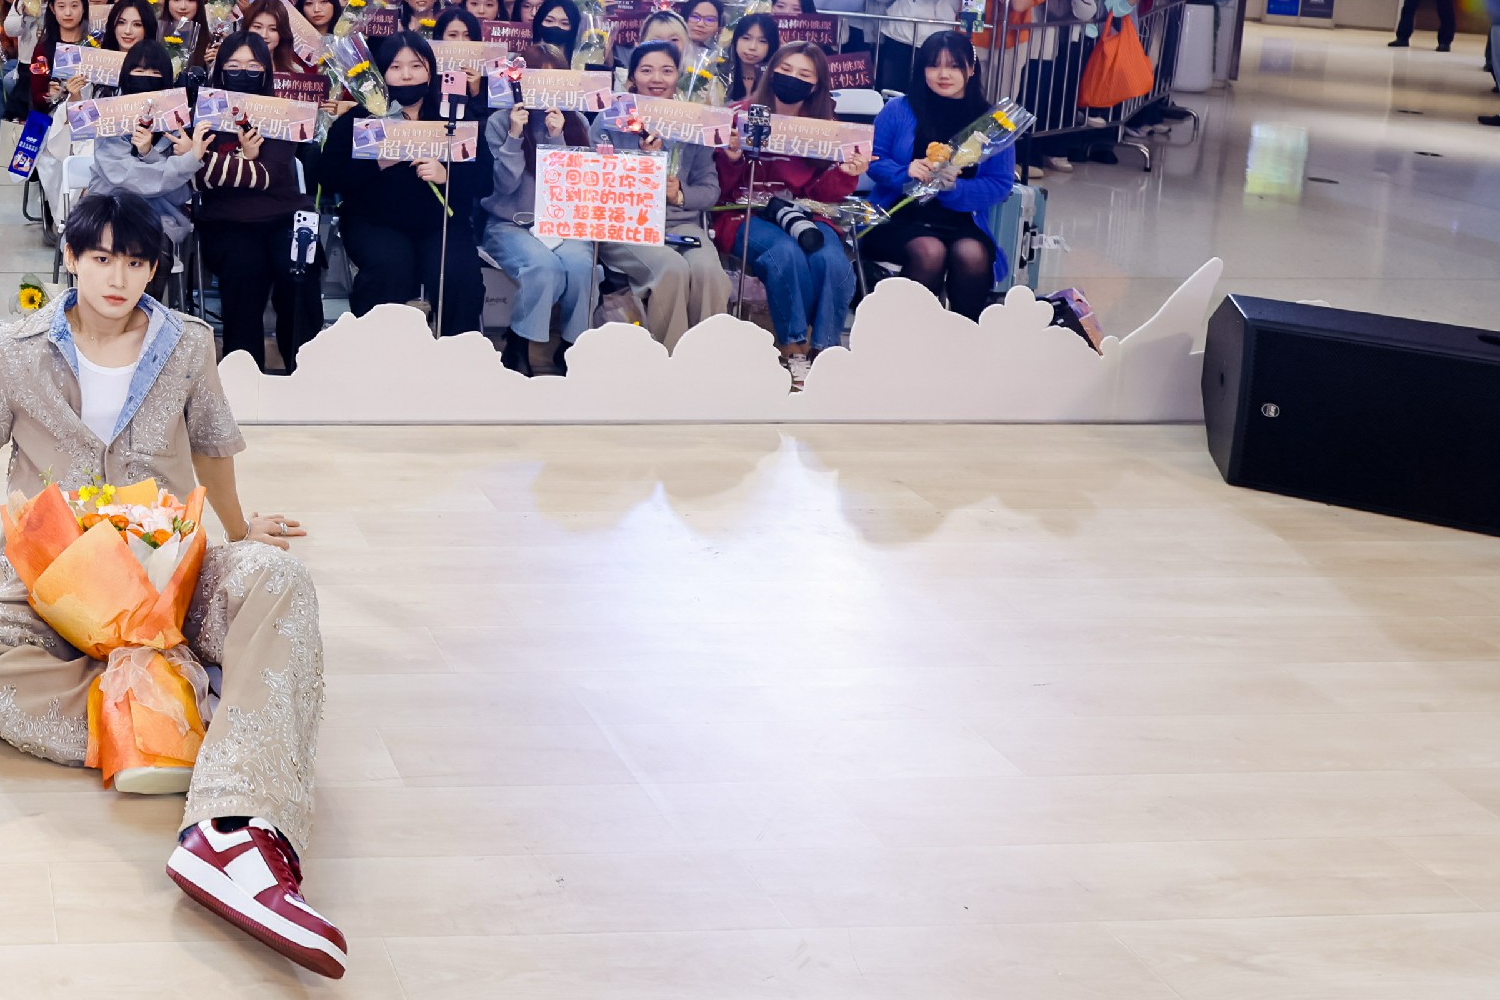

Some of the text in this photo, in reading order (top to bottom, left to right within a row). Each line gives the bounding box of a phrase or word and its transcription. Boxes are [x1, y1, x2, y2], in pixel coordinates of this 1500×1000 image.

[74, 63, 121, 85] 超好
[522, 88, 587, 109] 超好听
[377, 137, 450, 161] 超好听
[768, 131, 844, 160] 超好听
[572, 204, 627, 223] 超幸福
